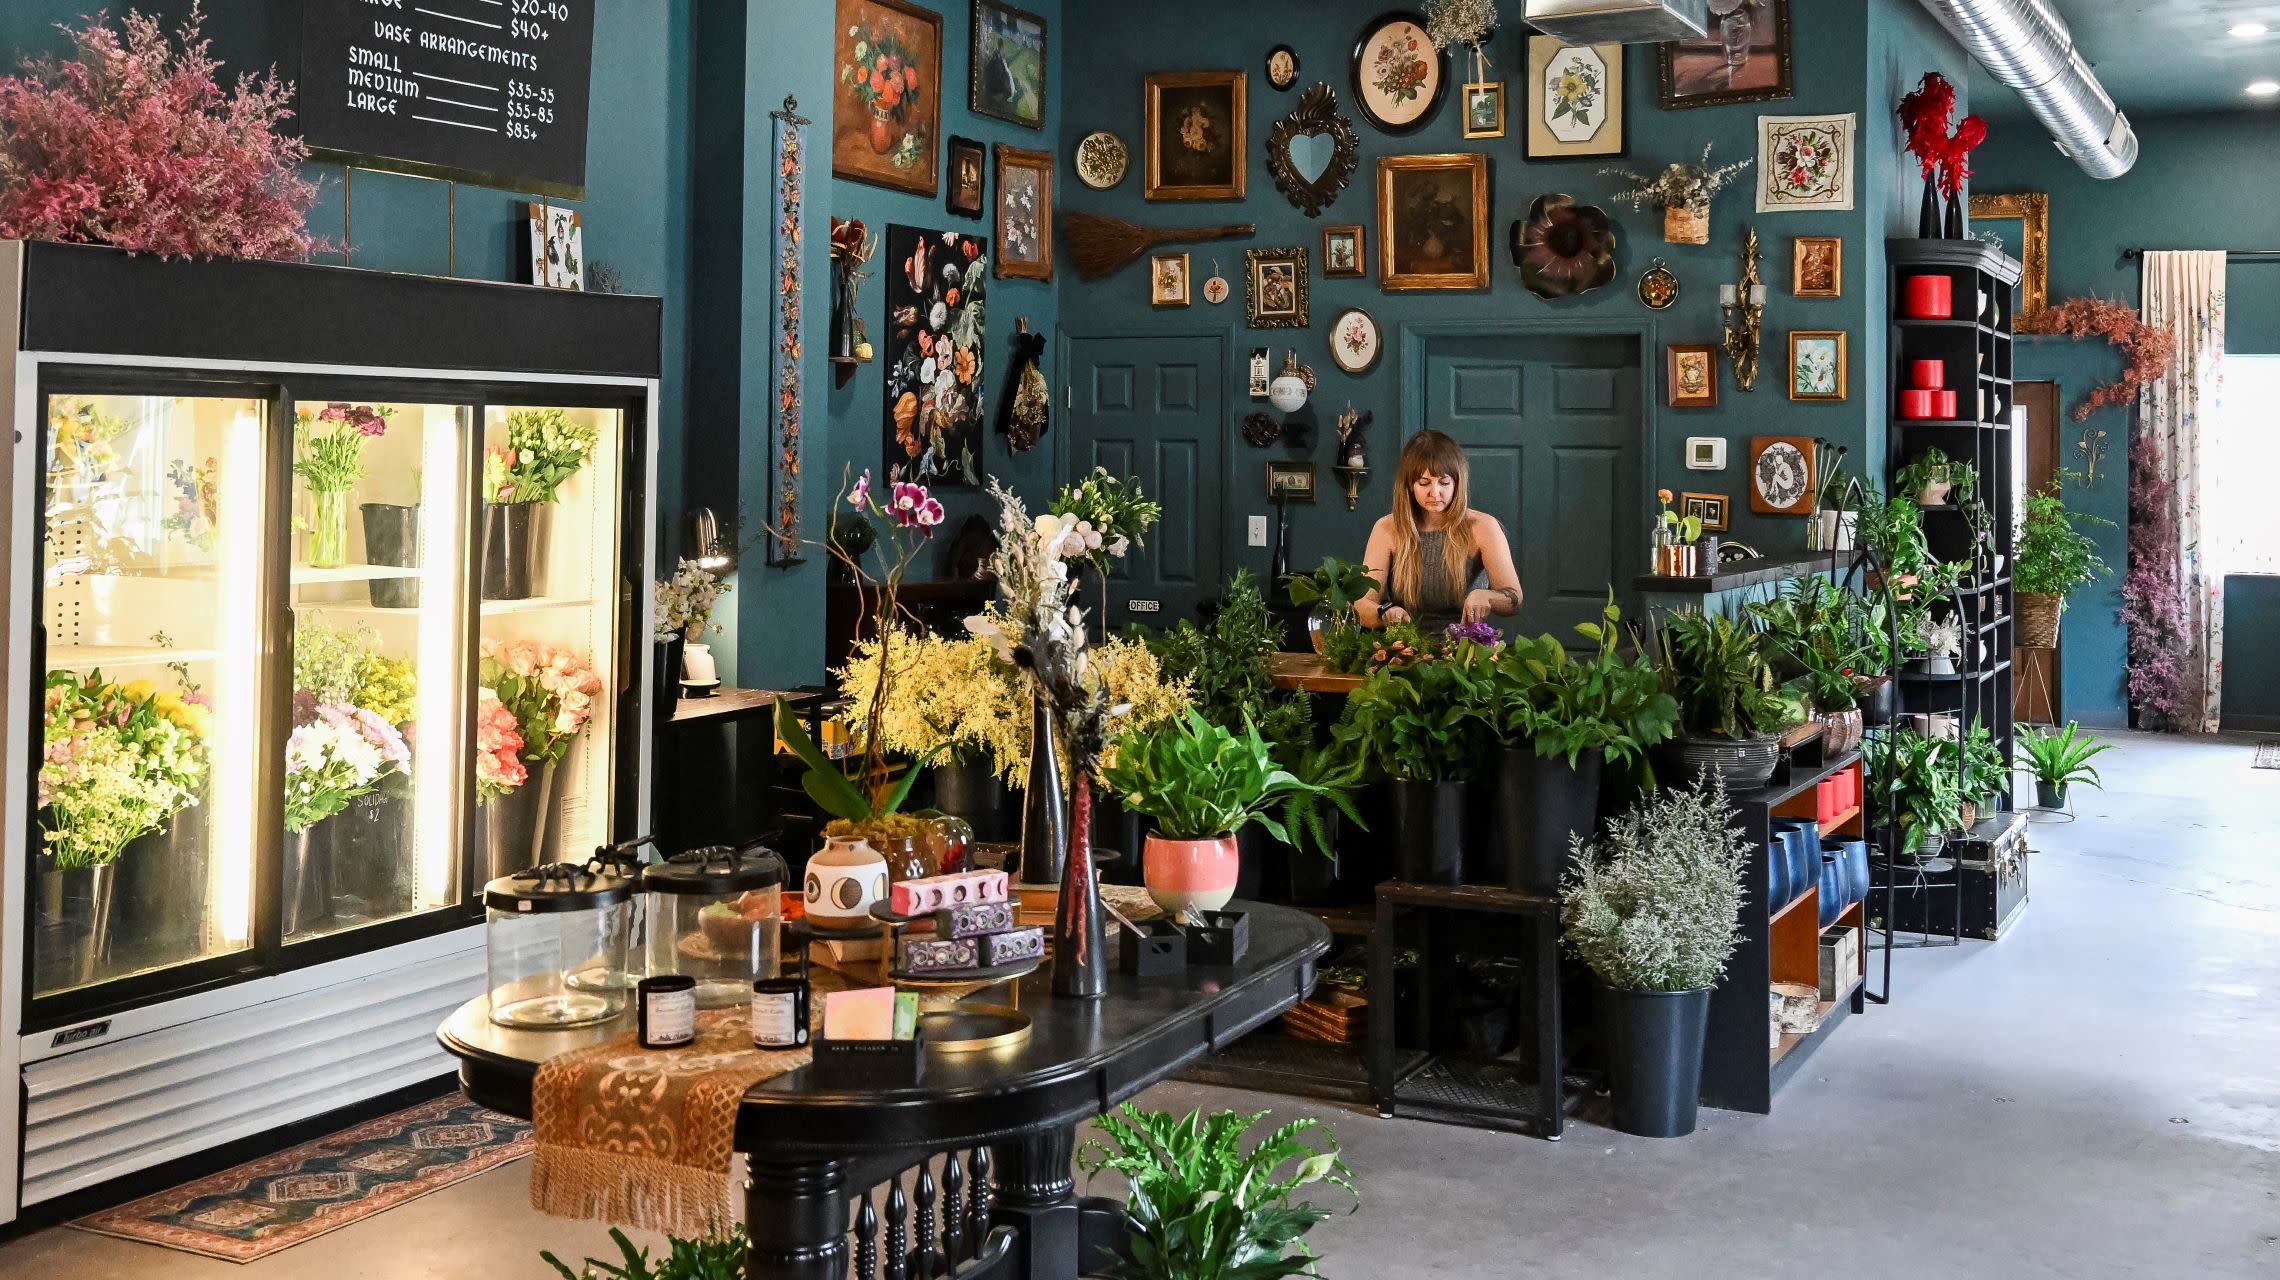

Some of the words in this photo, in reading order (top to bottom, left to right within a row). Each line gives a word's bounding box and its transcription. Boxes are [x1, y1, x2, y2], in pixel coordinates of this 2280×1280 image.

[511, 0, 568, 21] $20-40
[511, 17, 549, 40] $40+
[374, 20, 412, 44] VASE
[420, 31, 538, 71] ARRANGEMENTS
[349, 46, 402, 73] SMALL
[508, 78, 554, 103] $35-55
[348, 67, 420, 98] MEDIUM
[507, 99, 554, 124] $55-85
[347, 90, 398, 115] LARGE
[506, 119, 538, 140] $85+
[1131, 601, 1158, 610] OFFICE
[369, 808, 379, 822] $2
